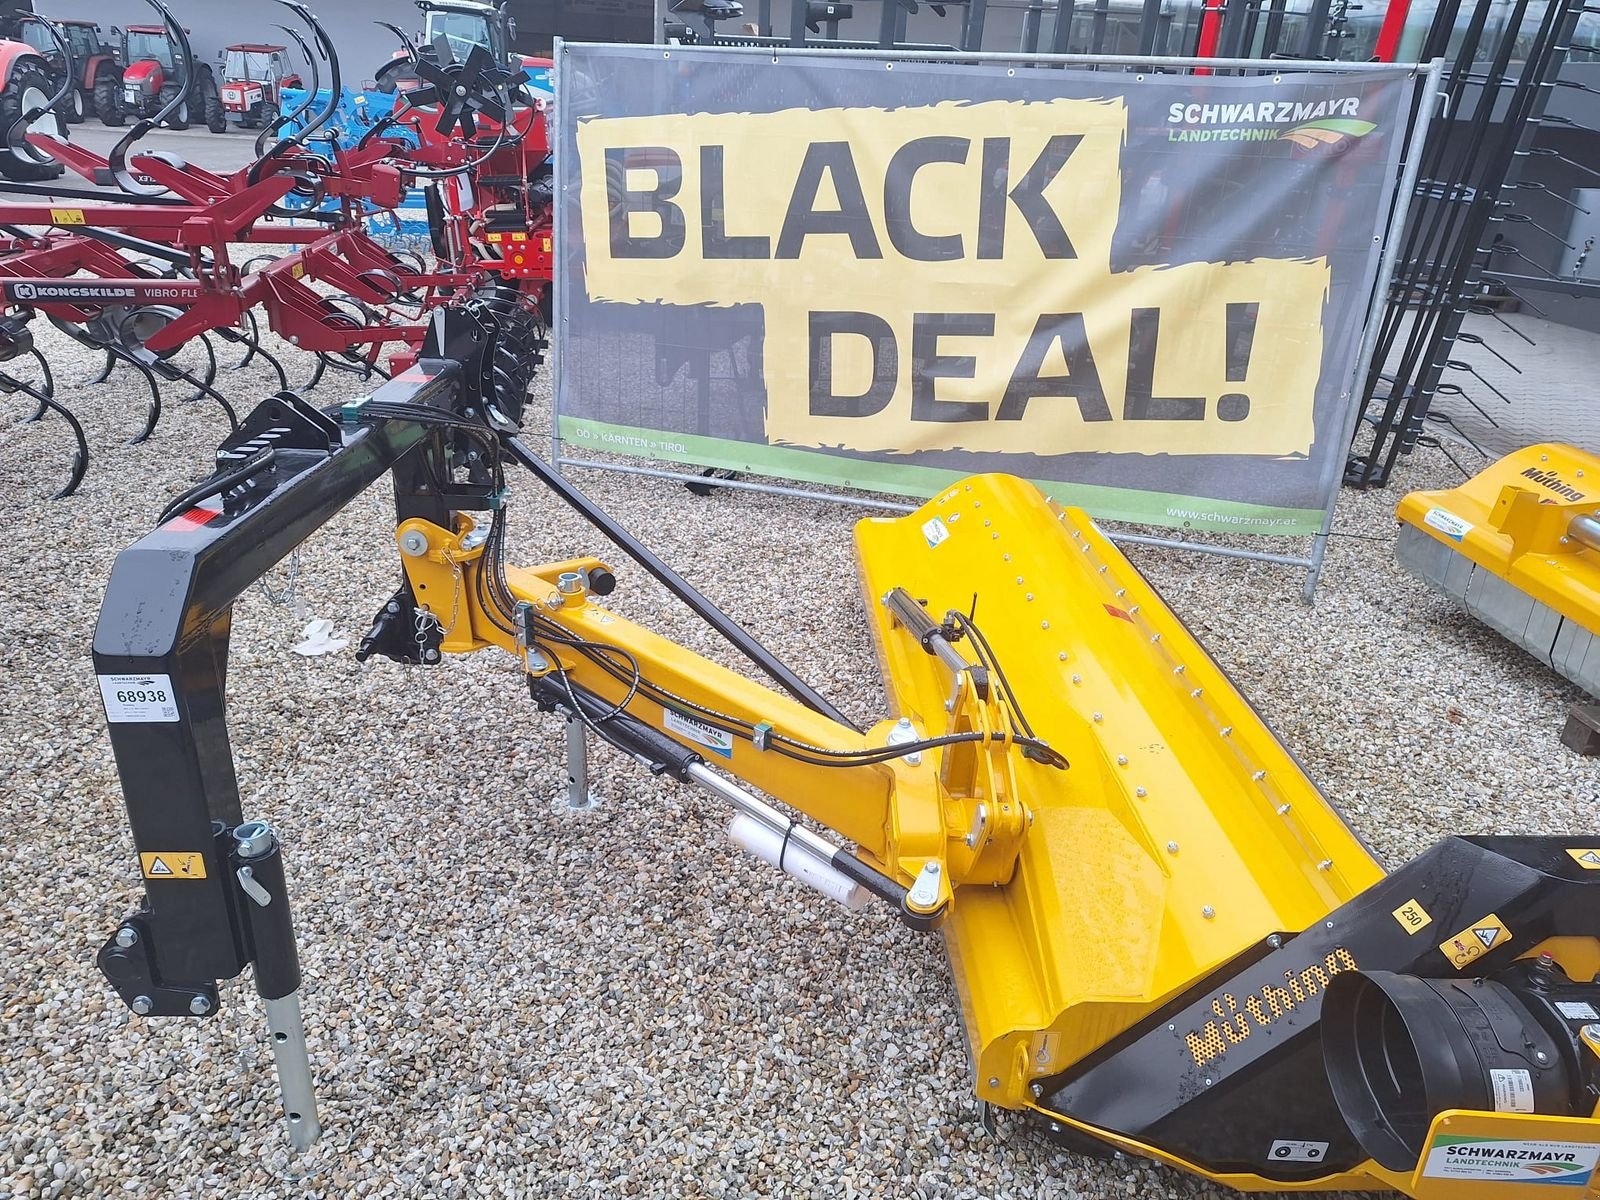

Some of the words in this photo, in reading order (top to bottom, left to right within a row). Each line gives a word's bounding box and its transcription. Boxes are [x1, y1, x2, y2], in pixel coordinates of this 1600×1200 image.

[1168, 97, 1360, 124] SCHWARZMAYR
[1168, 127, 1281, 143] LANDTECHNIK
[603, 133, 1085, 261] BLACK
[37, 287, 136, 297] KONGSKILDE
[144, 288, 178, 298] VIBRO
[808, 301, 1260, 422] DEAL!
[659, 441, 688, 454] TIROL
[1520, 467, 1585, 502] Müthing
[1166, 507, 1297, 526] www.schwarzmayr.at
[117, 690, 167, 703] 68938
[1402, 906, 1423, 926] 250
[1446, 1146, 1576, 1162] SCHWARZMAYR
[1446, 1157, 1521, 1168] LANDTECHNIK
